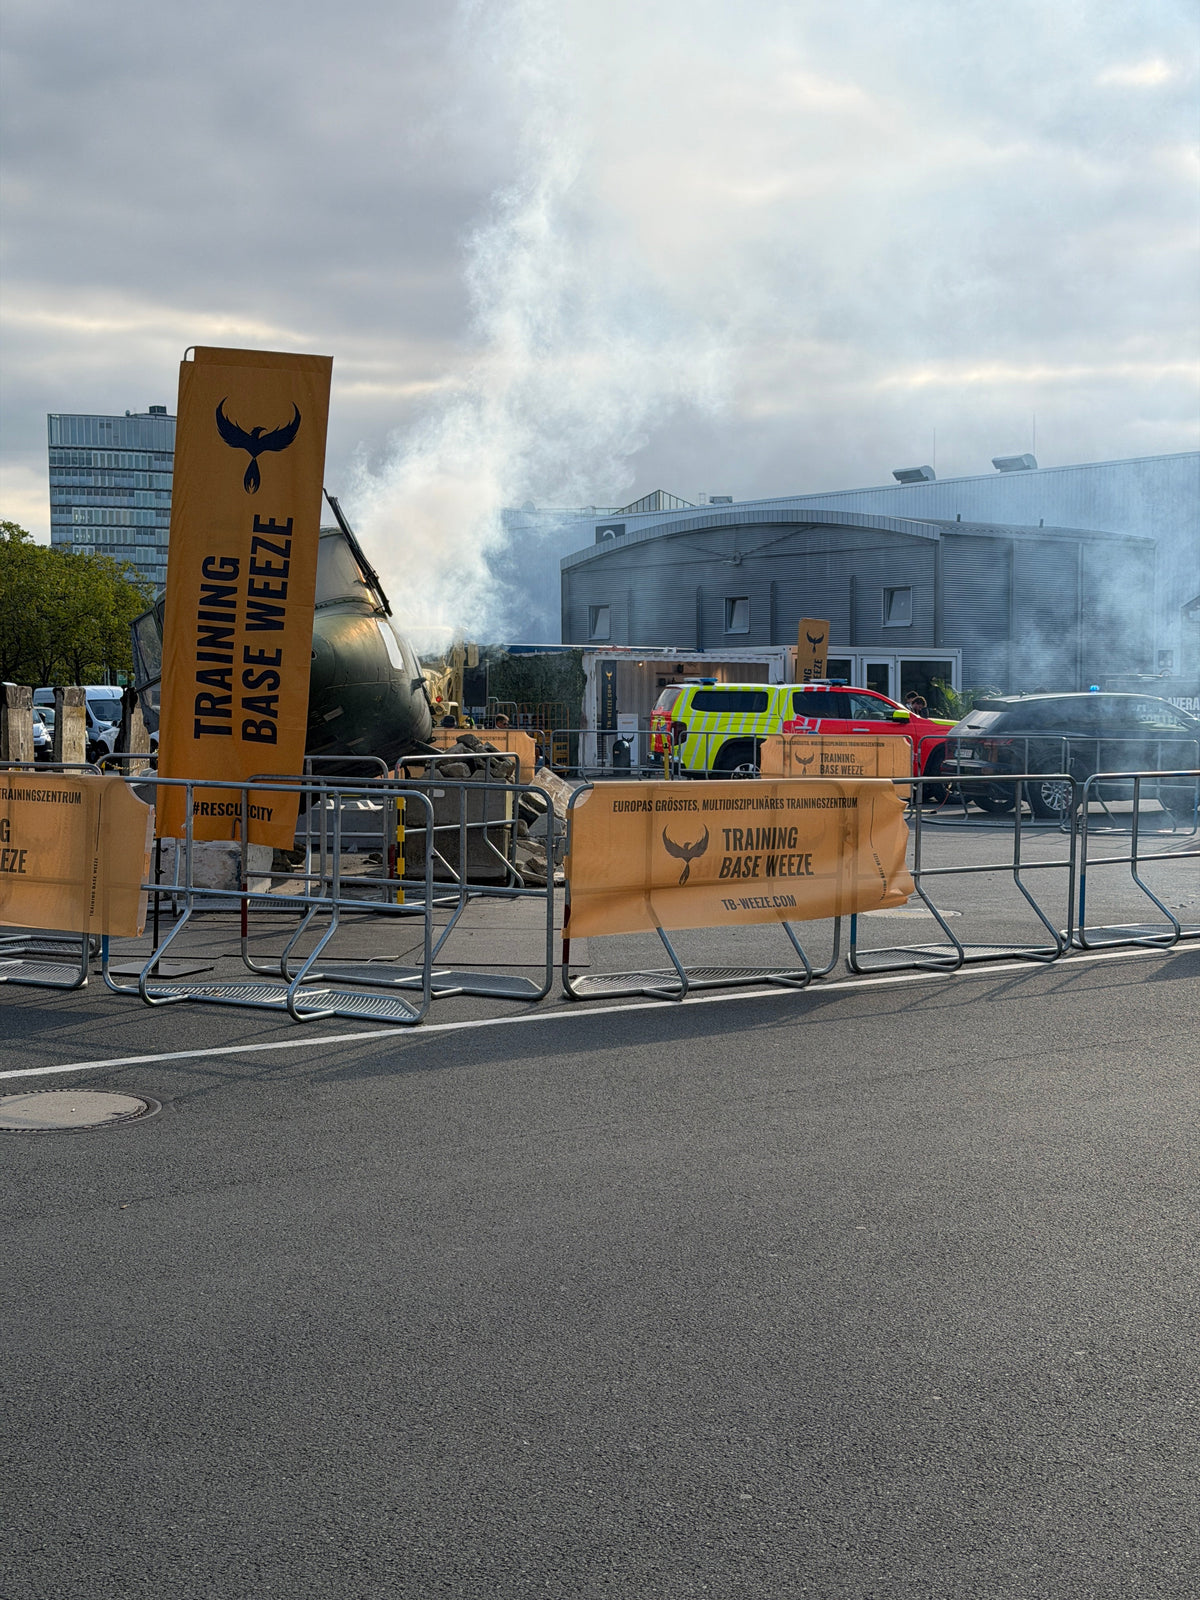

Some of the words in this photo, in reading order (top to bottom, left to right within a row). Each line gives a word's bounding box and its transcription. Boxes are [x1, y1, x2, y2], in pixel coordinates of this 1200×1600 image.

[245, 514, 293, 631] WEEZE
[194, 556, 240, 739] TRAINING
[242, 645, 282, 744] BASE
[820, 752, 856, 763] TRAINING
[820, 764, 839, 775] BASE
[841, 765, 864, 776] WEEZE
[0, 788, 82, 804] RAININGSZENTRUM
[613, 799, 653, 812] EUROPAS
[655, 796, 700, 812] GRÖSSTES,
[702, 795, 785, 811] MULTIDISZIPLINÄRES
[786, 796, 858, 809] TRAININGSZENTRUM
[193, 801, 273, 822] #RESCUCITY
[722, 827, 799, 851] TRAINING
[0, 848, 28, 873] EZE
[719, 855, 762, 878] BASE
[765, 853, 815, 877] WEEZE
[721, 894, 797, 911] TB-WEEZE.COM
